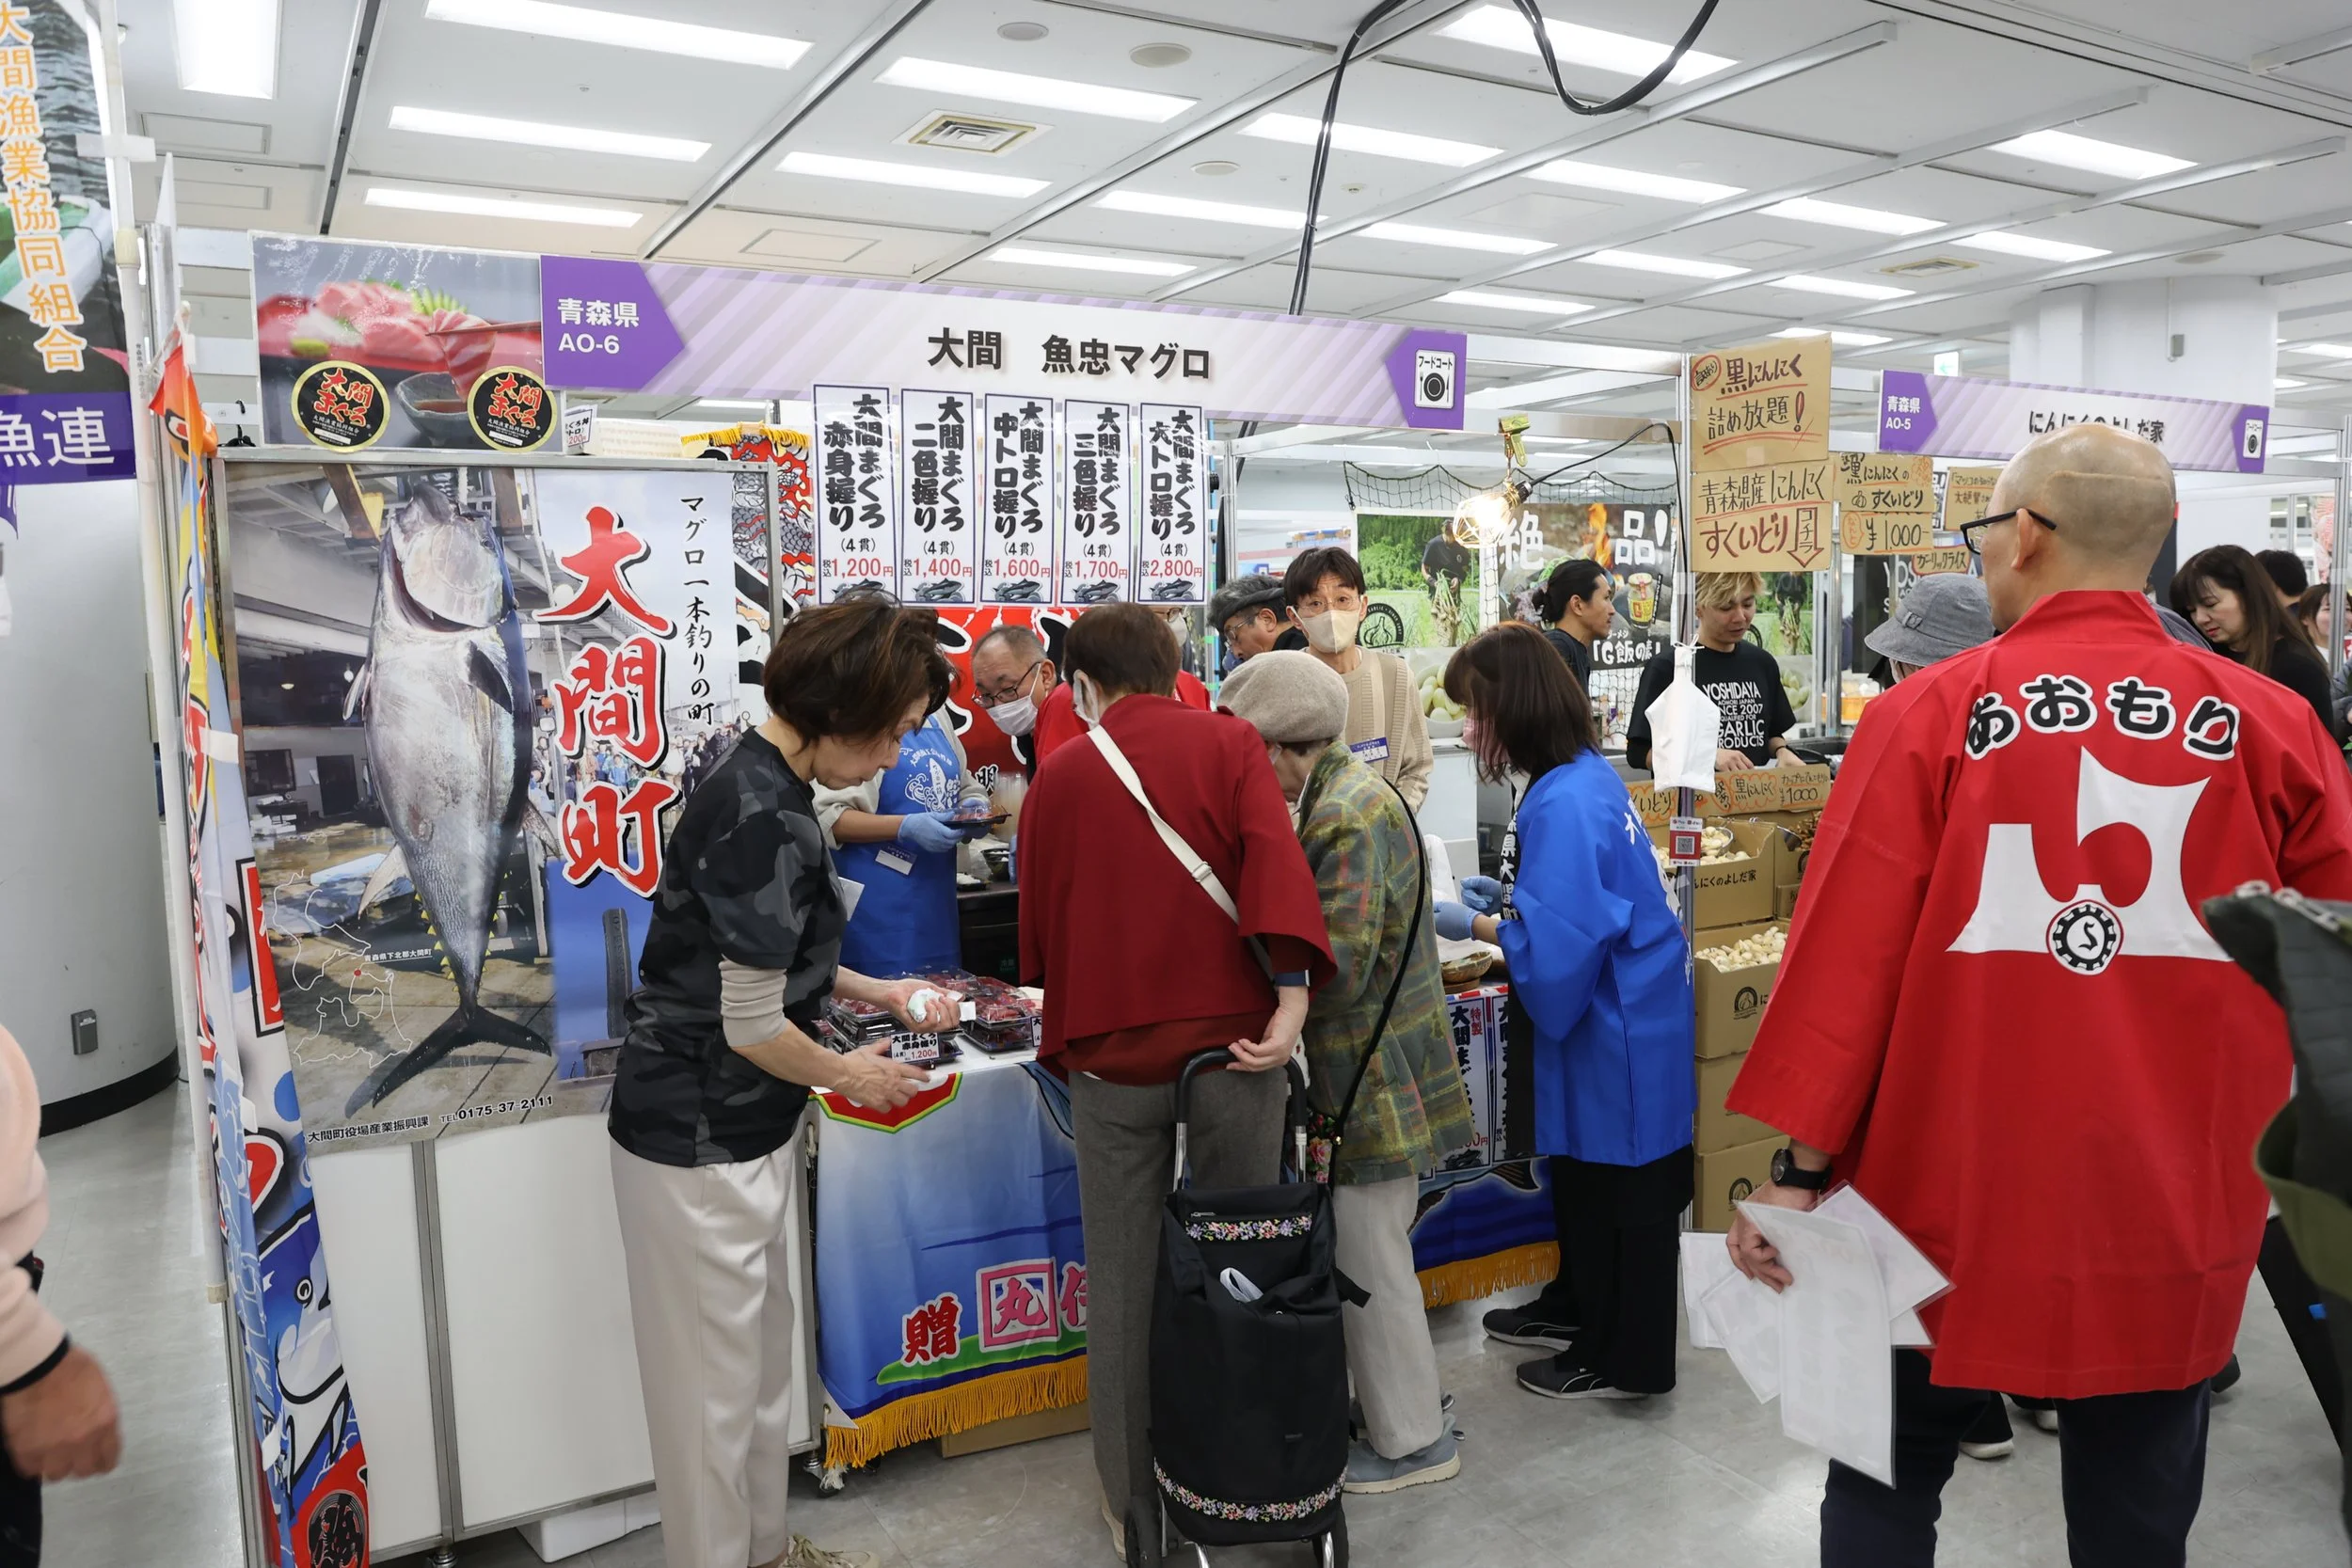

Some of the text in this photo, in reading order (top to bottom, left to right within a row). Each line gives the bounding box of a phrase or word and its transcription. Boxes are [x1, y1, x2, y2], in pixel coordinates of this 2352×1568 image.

[557, 297, 640, 328] 青森県
[558, 332, 621, 355] AO-6
[927, 326, 1210, 380] 大間 魚忠マグロ
[1418, 356, 1454, 372] フードコート
[1720, 353, 1804, 395] 黒にんにく
[313, 388, 367, 428] まぐろ
[320, 367, 374, 409] 大間
[494, 372, 544, 412] 大間
[1886, 395, 1921, 414] 青森県
[487, 393, 537, 429] まぐろ
[1884, 416, 1912, 431] AO-5
[824, 421, 857, 532] 赤身握り
[852, 394, 885, 529] 大間まぐろ
[912, 423, 939, 533] 二色握り
[938, 396, 965, 531] 大間まぐろ
[993, 412, 1020, 540] 中トロ握り
[1019, 401, 1044, 533] 大間まぐろ
[1097, 406, 1121, 535] 大間まぐろ
[1149, 420, 1174, 541] 大トロ握り
[1171, 409, 1196, 535] 大間まぐろ
[1073, 433, 1099, 538] 三色握り
[1698, 466, 1827, 515] 青森県産にんにく
[1871, 489, 1925, 510] すくいどり
[840, 537, 877, 553] (4貫)
[923, 540, 955, 556] (4貫)
[1004, 542, 1035, 557] (4貫)
[1083, 543, 1112, 558] (4貫)
[1160, 543, 1188, 558] (4貫)
[1699, 513, 1789, 561] すくいどり
[1798, 510, 1814, 554] コチラ
[680, 497, 717, 726] マグロ一本釣りの町
[534, 503, 678, 898] 大間町
[1702, 681, 1762, 701] YOSHIDAYA
[1720, 704, 1764, 716] NCE 2007
[1718, 720, 1765, 738] GARLIC
[1967, 676, 2237, 756] あおもり
[1718, 736, 1765, 750] RODUCTS
[1693, 869, 1757, 890] にくのよしだ家
[307, 1116, 430, 1144] 大間町役場産業振興課
